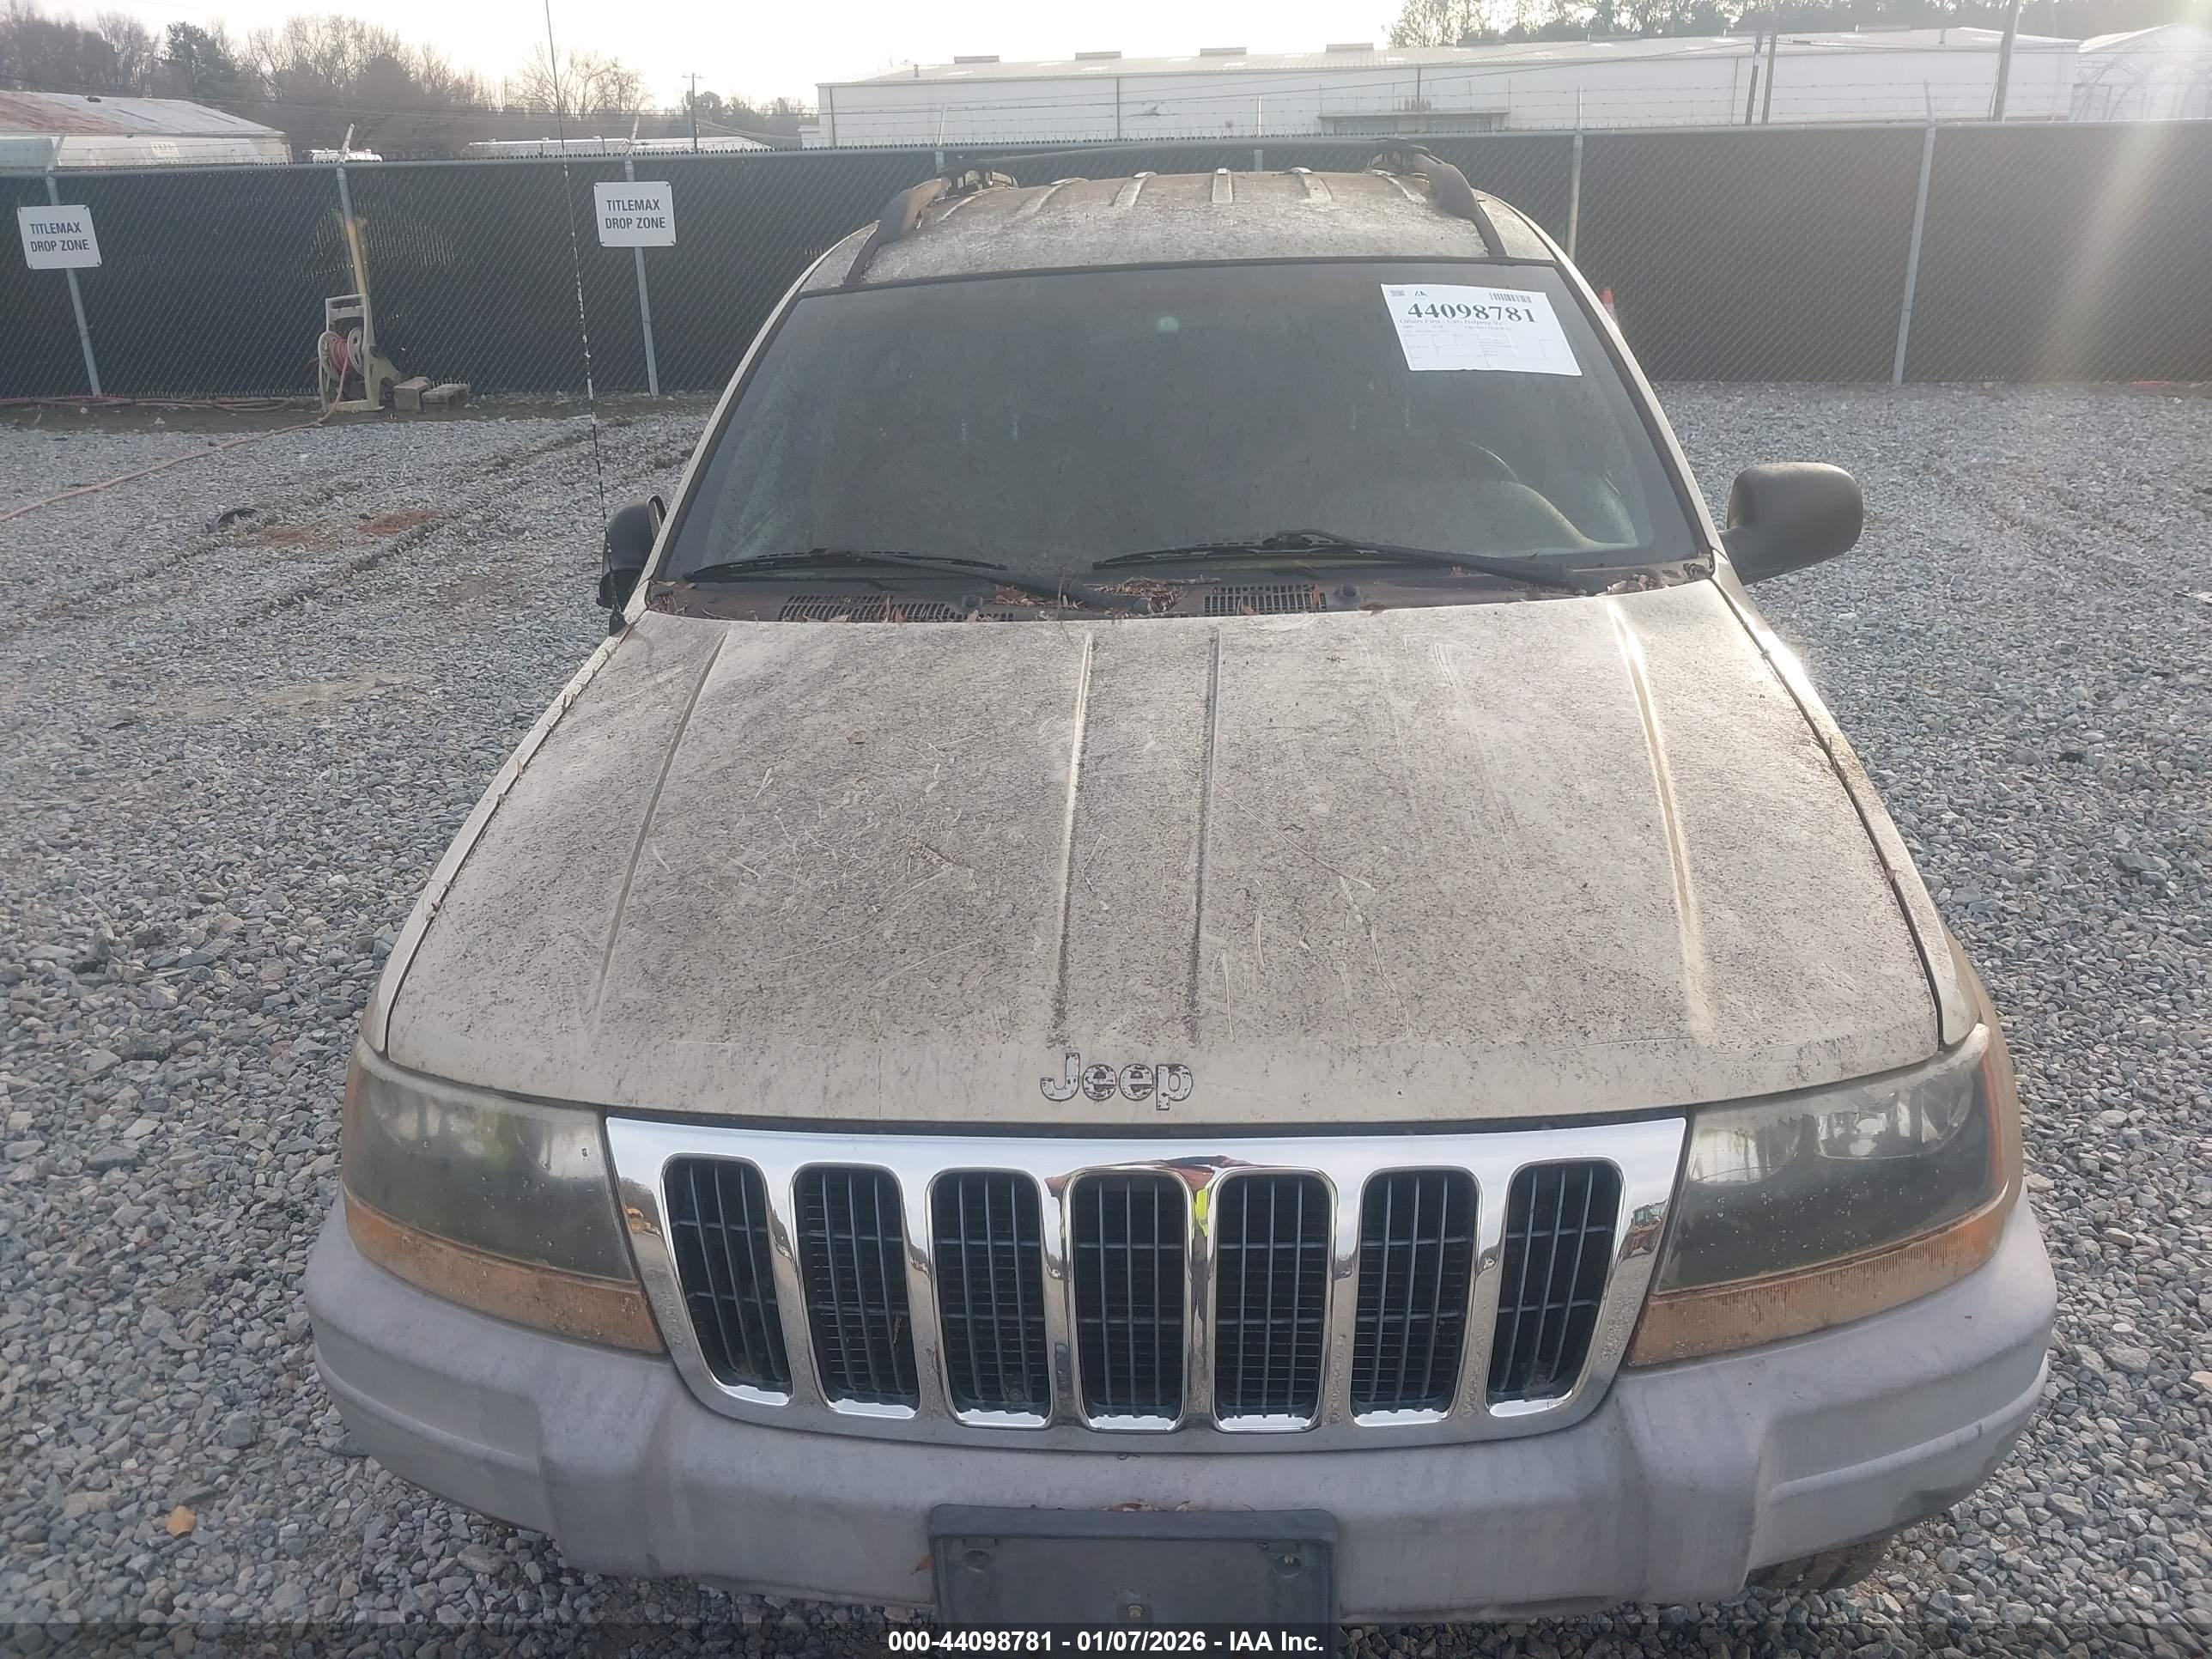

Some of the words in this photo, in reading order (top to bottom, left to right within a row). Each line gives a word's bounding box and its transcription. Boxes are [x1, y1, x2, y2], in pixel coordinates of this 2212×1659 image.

[605, 198, 660, 211] TITLEMAX
[29, 222, 82, 234] TITLEMAX
[605, 217, 633, 229] DROP
[635, 216, 666, 228] ZONE
[30, 240, 58, 252] DROP
[59, 239, 90, 252] ZONE
[1407, 302, 1538, 324] 44098781
[1040, 1053, 1194, 1110] Jeep
